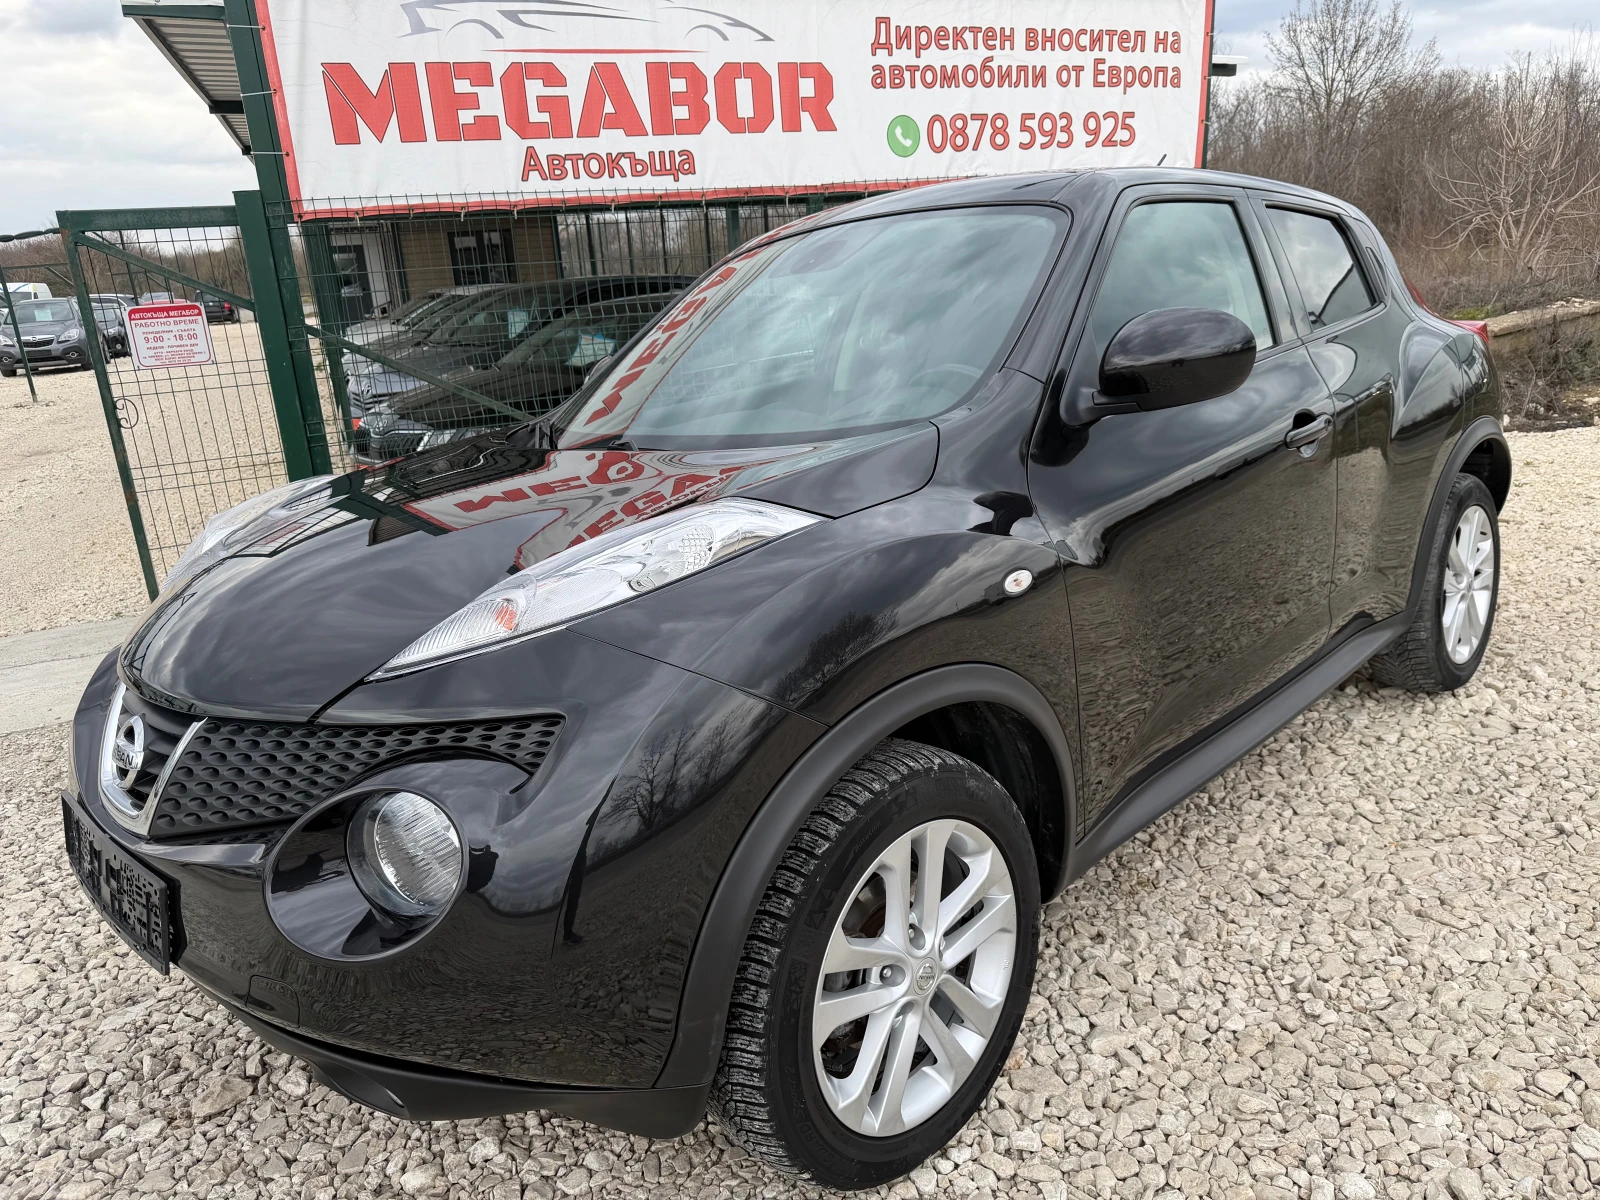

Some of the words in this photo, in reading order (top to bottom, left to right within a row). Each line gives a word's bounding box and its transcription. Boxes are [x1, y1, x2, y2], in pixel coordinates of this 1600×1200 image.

[870, 17, 1015, 58] Директен
[1025, 28, 1146, 52] вносител
[1154, 30, 1181, 53] на
[871, 56, 1047, 89] автомобили
[1056, 64, 1084, 88] от
[1092, 58, 1181, 94] Европа
[321, 61, 837, 145] MEGABOR
[926, 113, 1010, 153] 0878
[1019, 112, 1074, 150] 593
[1083, 111, 1136, 148] 925
[521, 145, 697, 182] Автокъща
[131, 311, 168, 319] АВТОКЪЩА
[169, 309, 199, 317] МЕГАБОР
[134, 320, 172, 328] РАБОТНО
[144, 335, 164, 343] 9:00
[173, 333, 198, 341] 18:00
